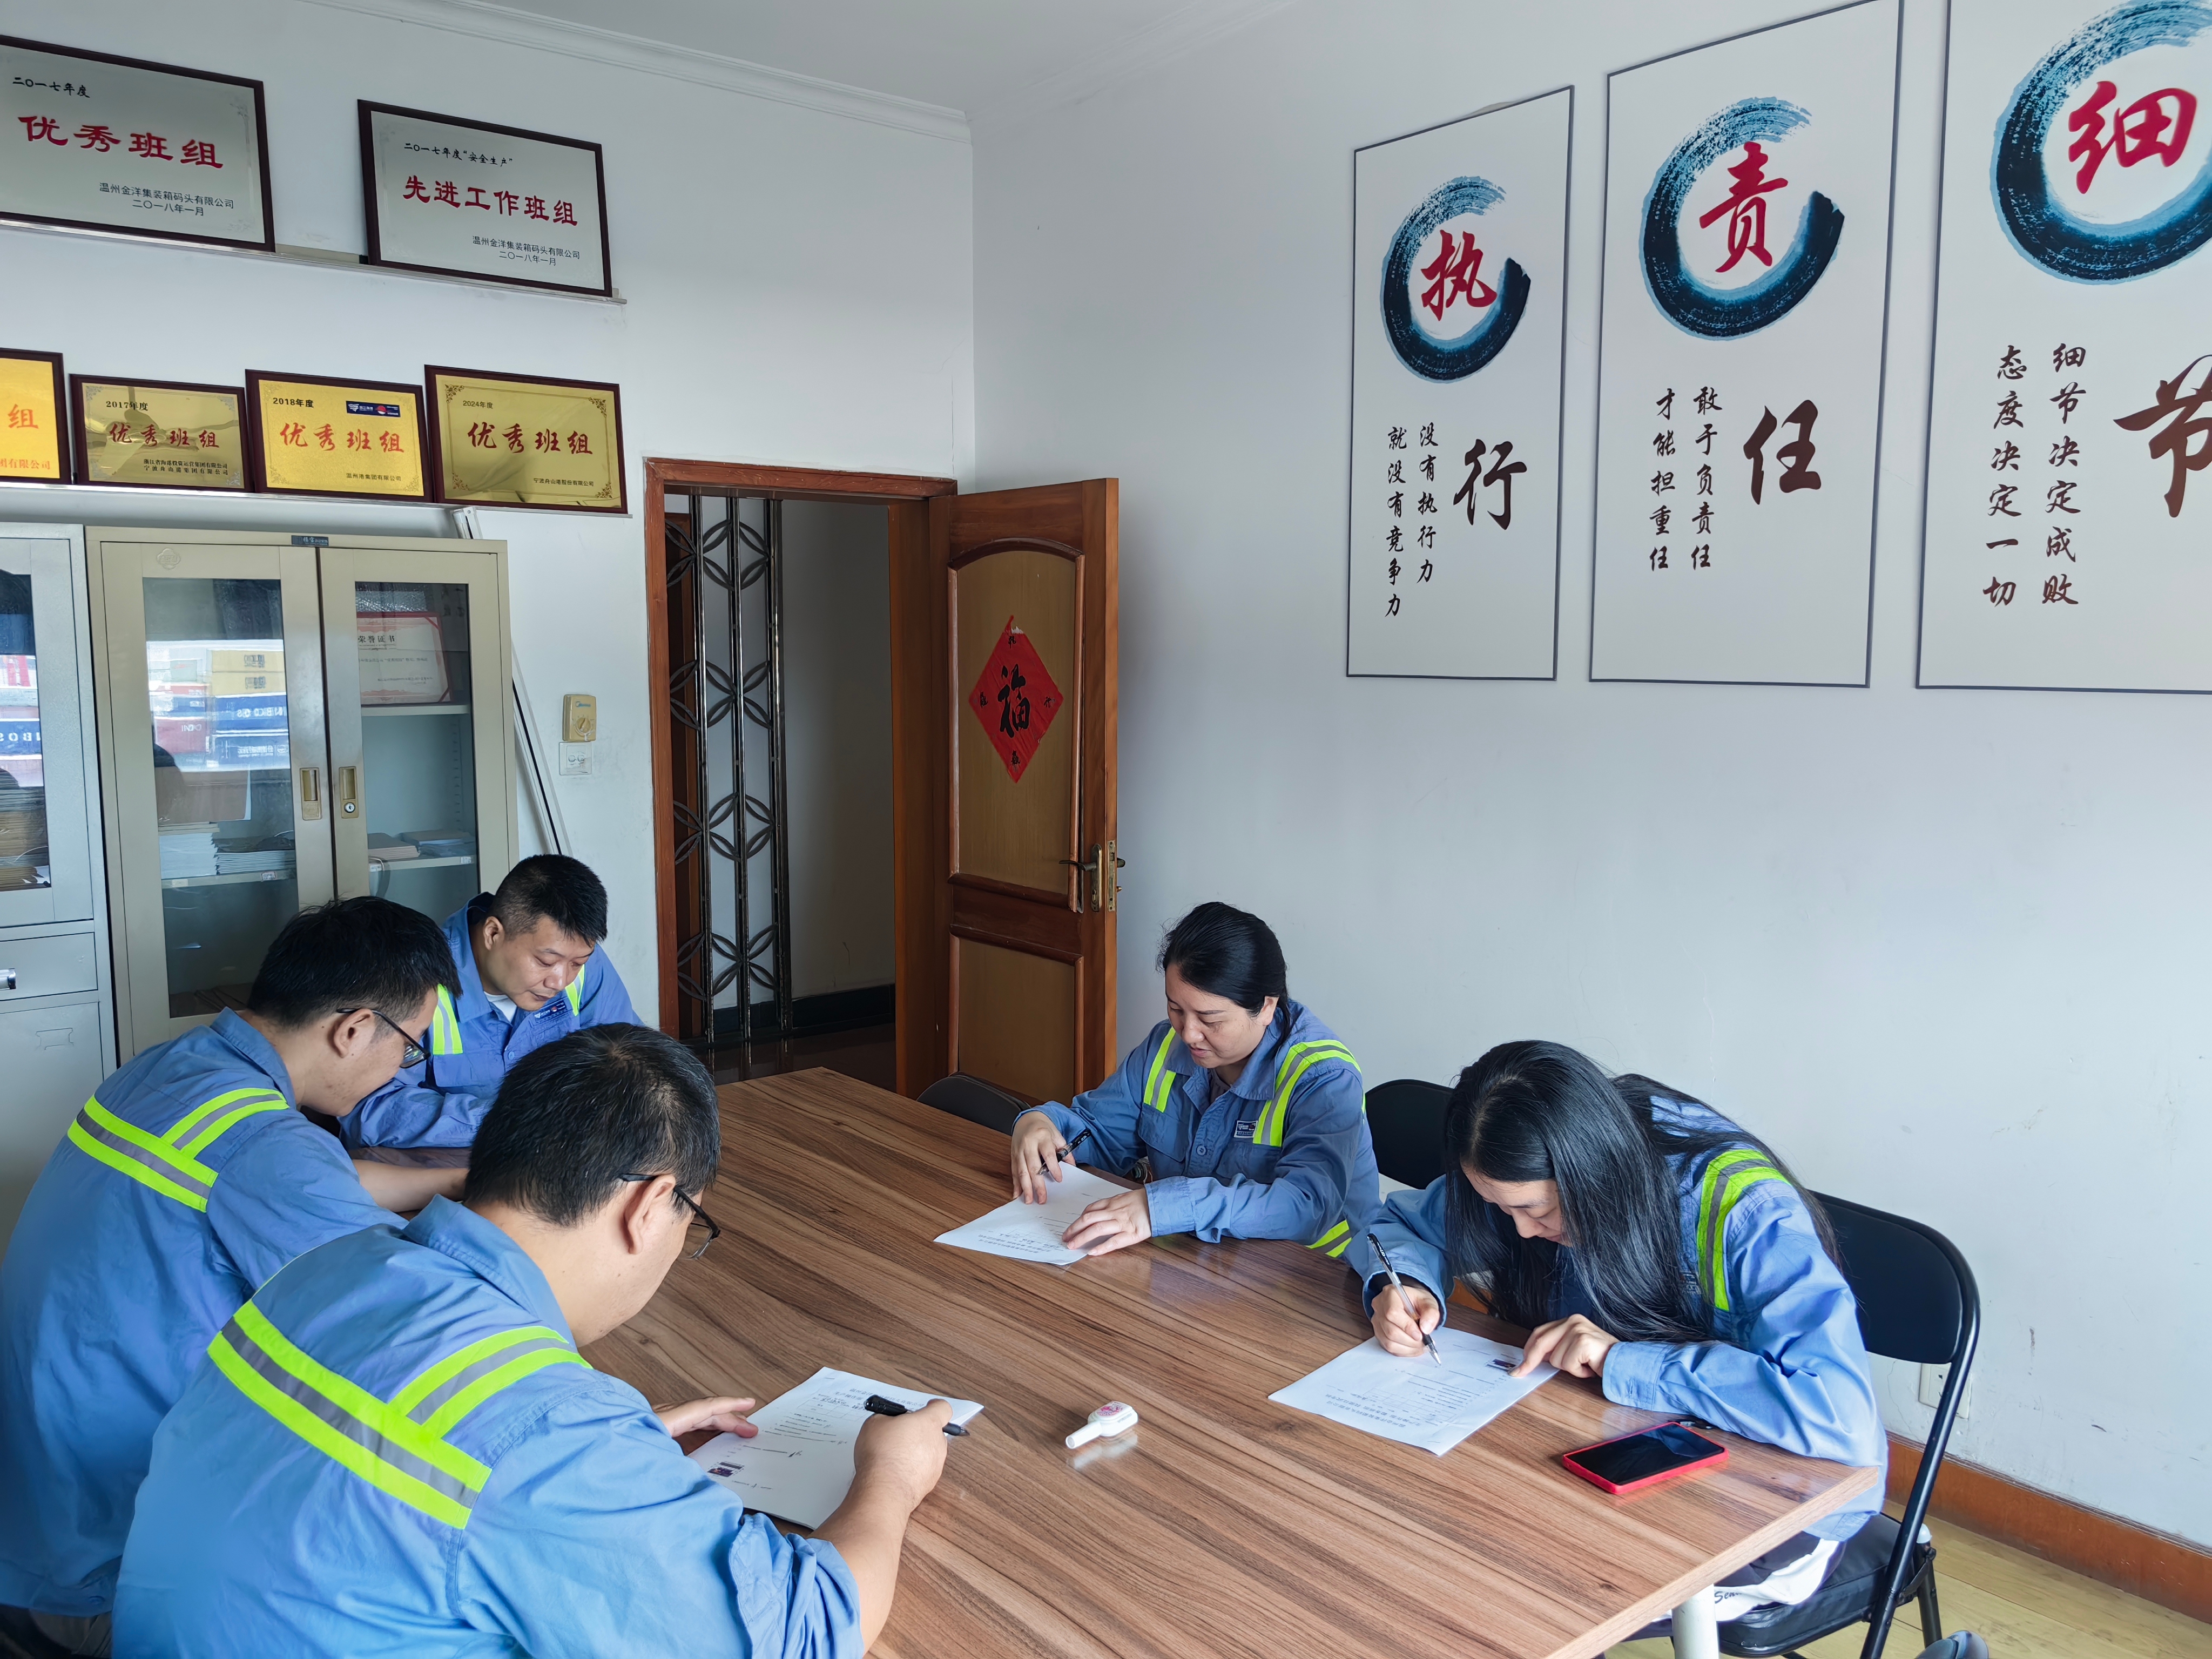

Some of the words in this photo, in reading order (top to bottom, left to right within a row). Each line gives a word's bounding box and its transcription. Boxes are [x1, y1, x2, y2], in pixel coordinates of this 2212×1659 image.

[18, 116, 224, 168] 优秀班组
[2068, 80, 2197, 194] 细
[99, 182, 234, 210] 温州金洋集装箱码头有限公司
[402, 175, 578, 226] 先进工作班组
[1699, 141, 1789, 273] 责
[472, 235, 580, 260] 温州金洋集装箱码头有限公司
[1421, 230, 1498, 321] 执
[8, 403, 39, 429] 组
[105, 400, 149, 412] 2017年度
[272, 397, 314, 409] 2018年度
[462, 400, 494, 409] 2024年度
[109, 423, 219, 449] 优秀班组
[279, 422, 404, 453] 优秀班组
[467, 421, 594, 455] 优秀班组
[1743, 399, 1822, 505] 任
[346, 473, 401, 481] 温州港集团有限公司
[534, 477, 594, 487] 宁波舟山港股份有限公司
[1453, 439, 1527, 530] 行
[1649, 388, 1676, 571] 才能担重任
[1690, 386, 1723, 570] 敢于负责任
[1982, 345, 2027, 608] 态度决定一切
[2042, 343, 2087, 605] 细节决定成败
[1385, 426, 1407, 617] 就没有竞争力
[1416, 422, 1439, 584] 没有执行力
[997, 664, 1031, 738] 福
